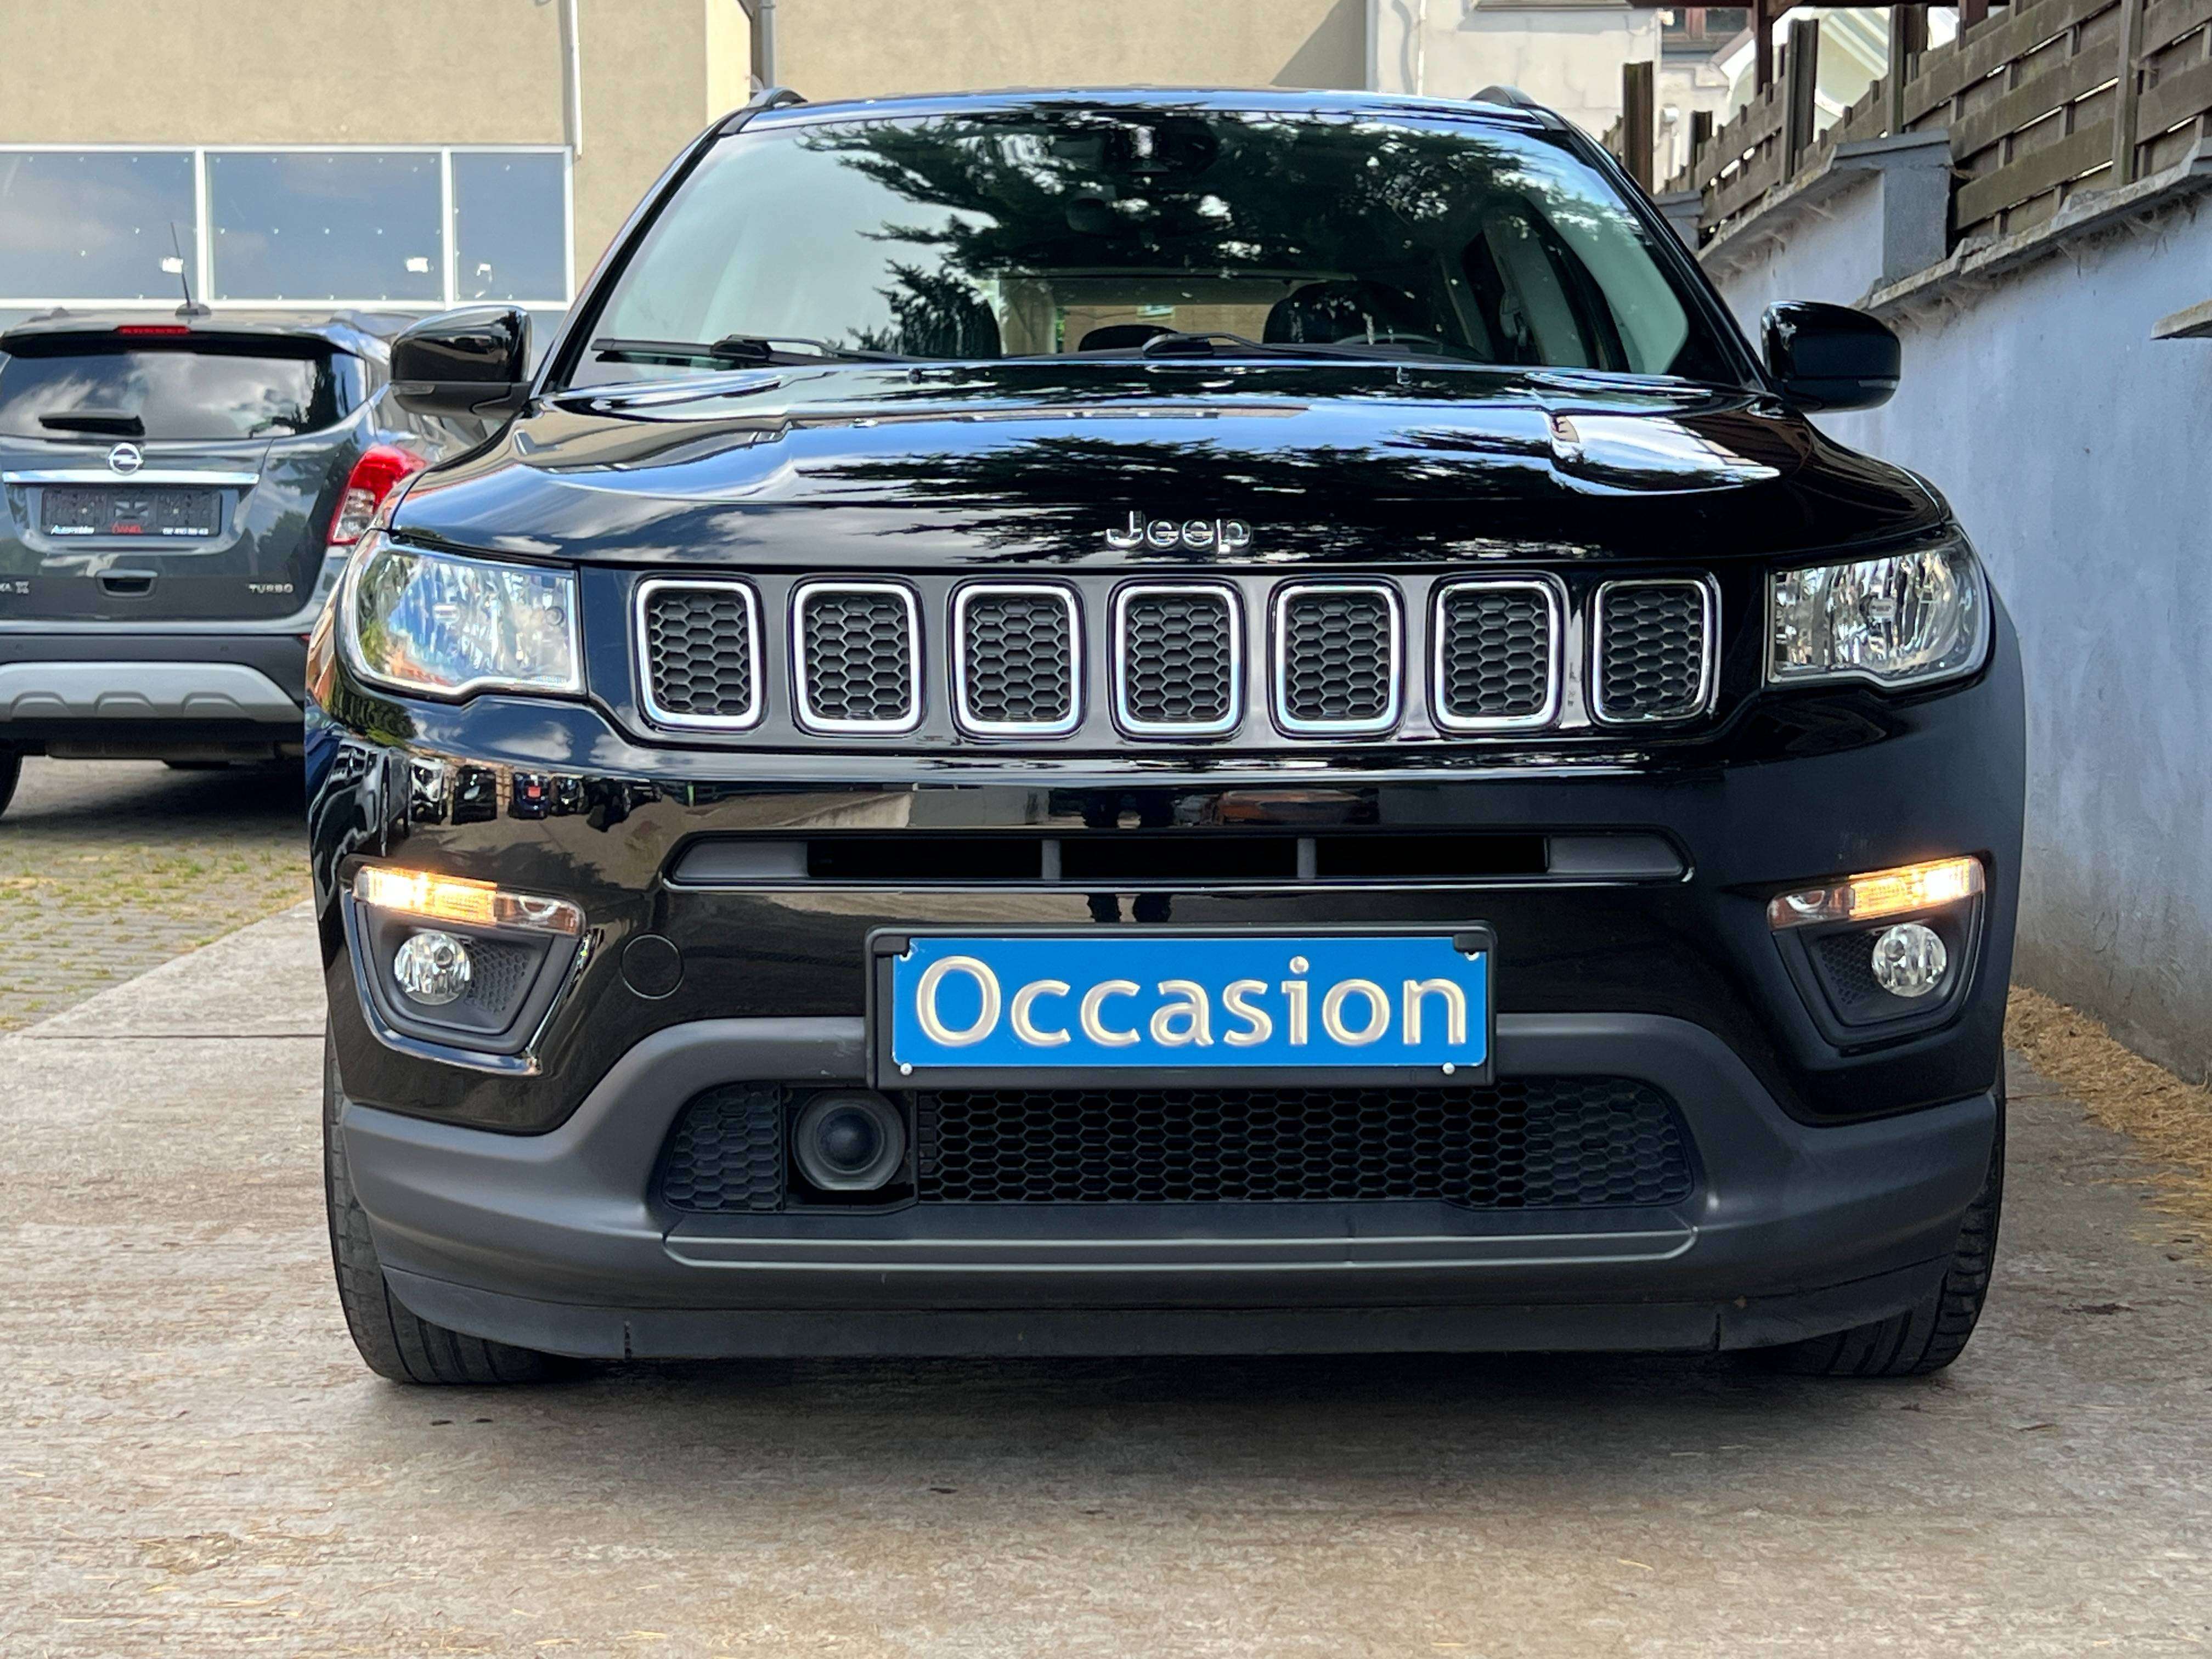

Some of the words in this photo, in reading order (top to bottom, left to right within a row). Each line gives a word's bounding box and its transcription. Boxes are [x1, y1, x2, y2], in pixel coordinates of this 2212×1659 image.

[1105, 510, 1252, 554] Jeep
[249, 583, 294, 593] TURBO
[915, 955, 1468, 1047] Occasion
